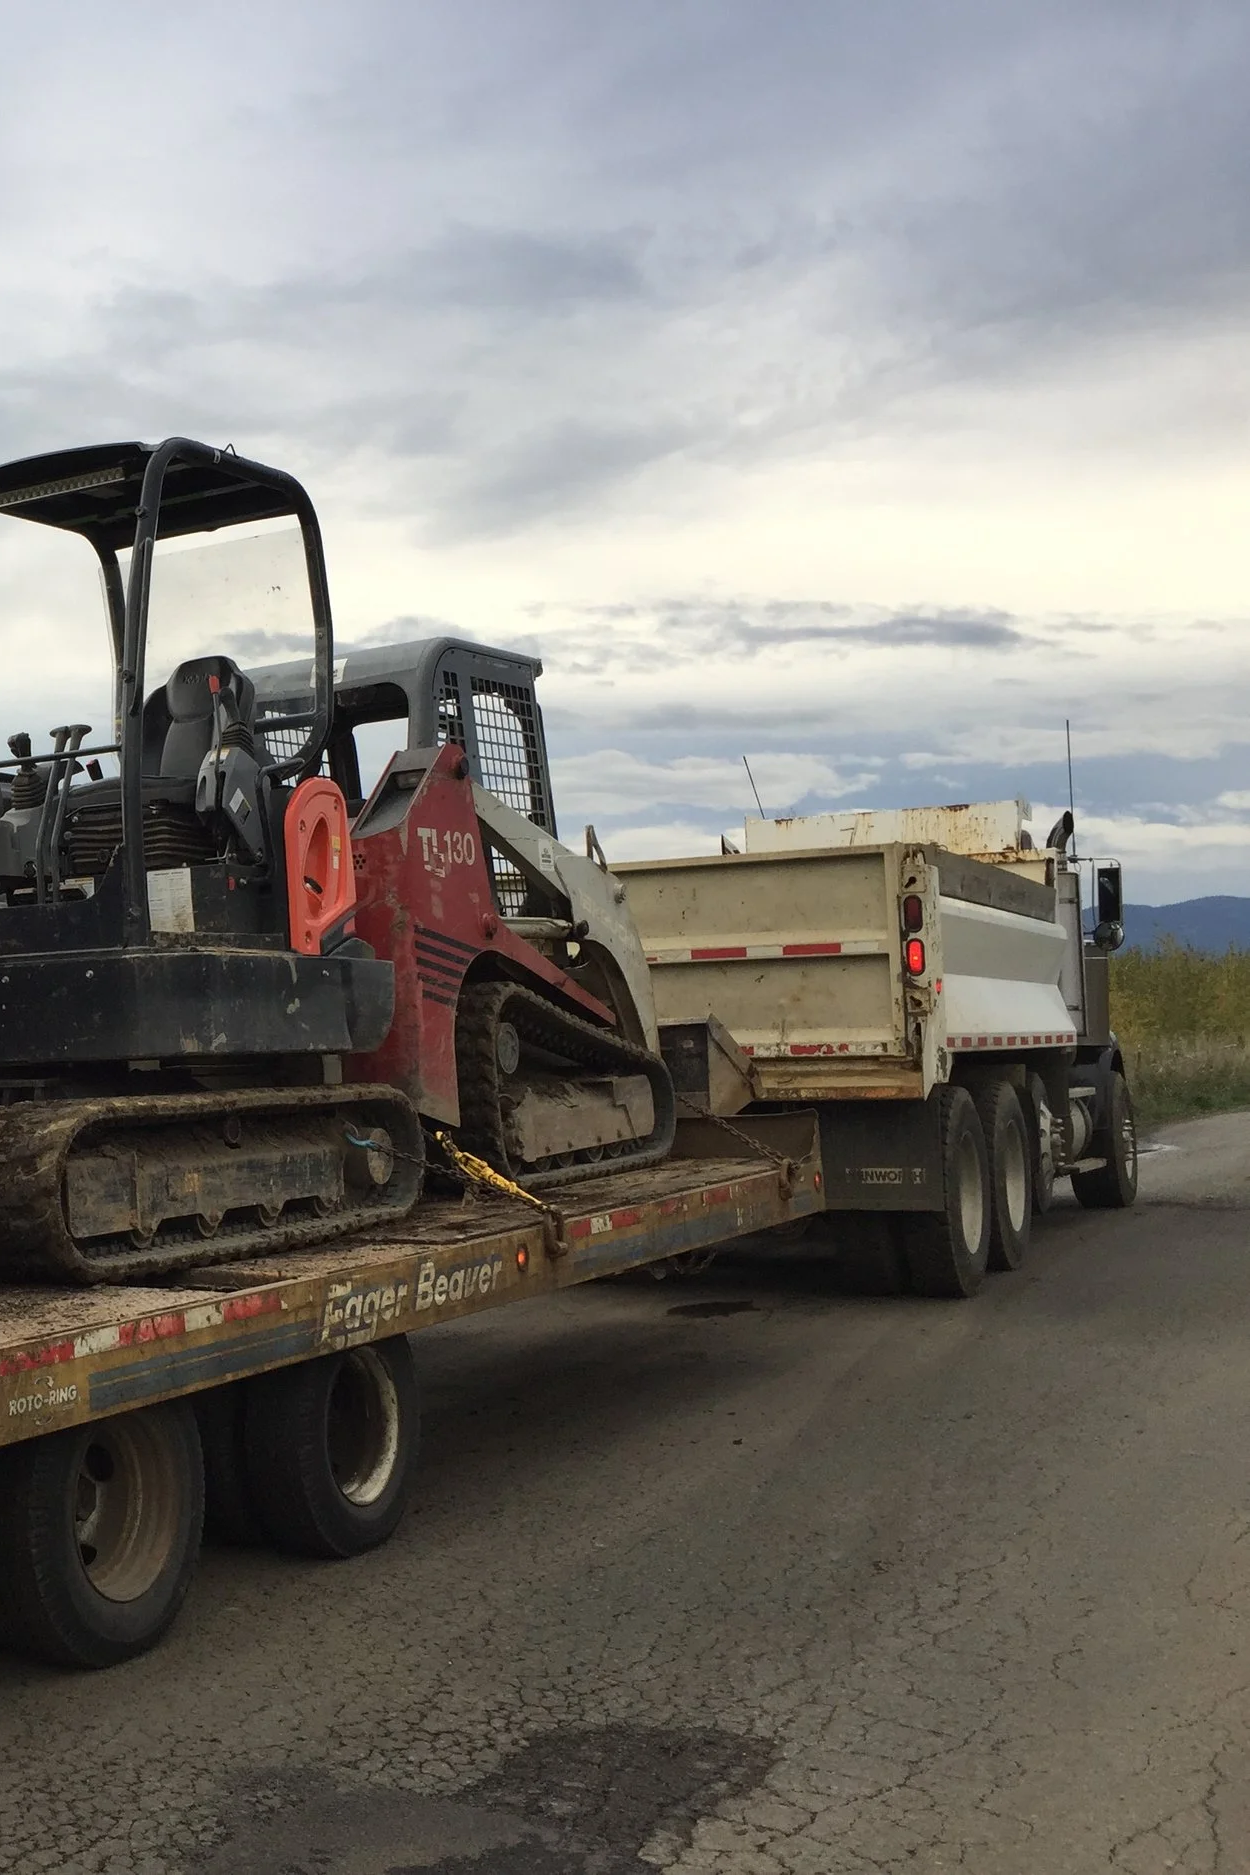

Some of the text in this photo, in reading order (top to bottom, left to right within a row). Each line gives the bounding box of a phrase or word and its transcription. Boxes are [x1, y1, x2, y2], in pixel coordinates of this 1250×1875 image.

[845, 1168, 926, 1184] NWOH
[415, 1256, 503, 1312] Beaver
[9, 1384, 77, 1416] ROTO-RING
